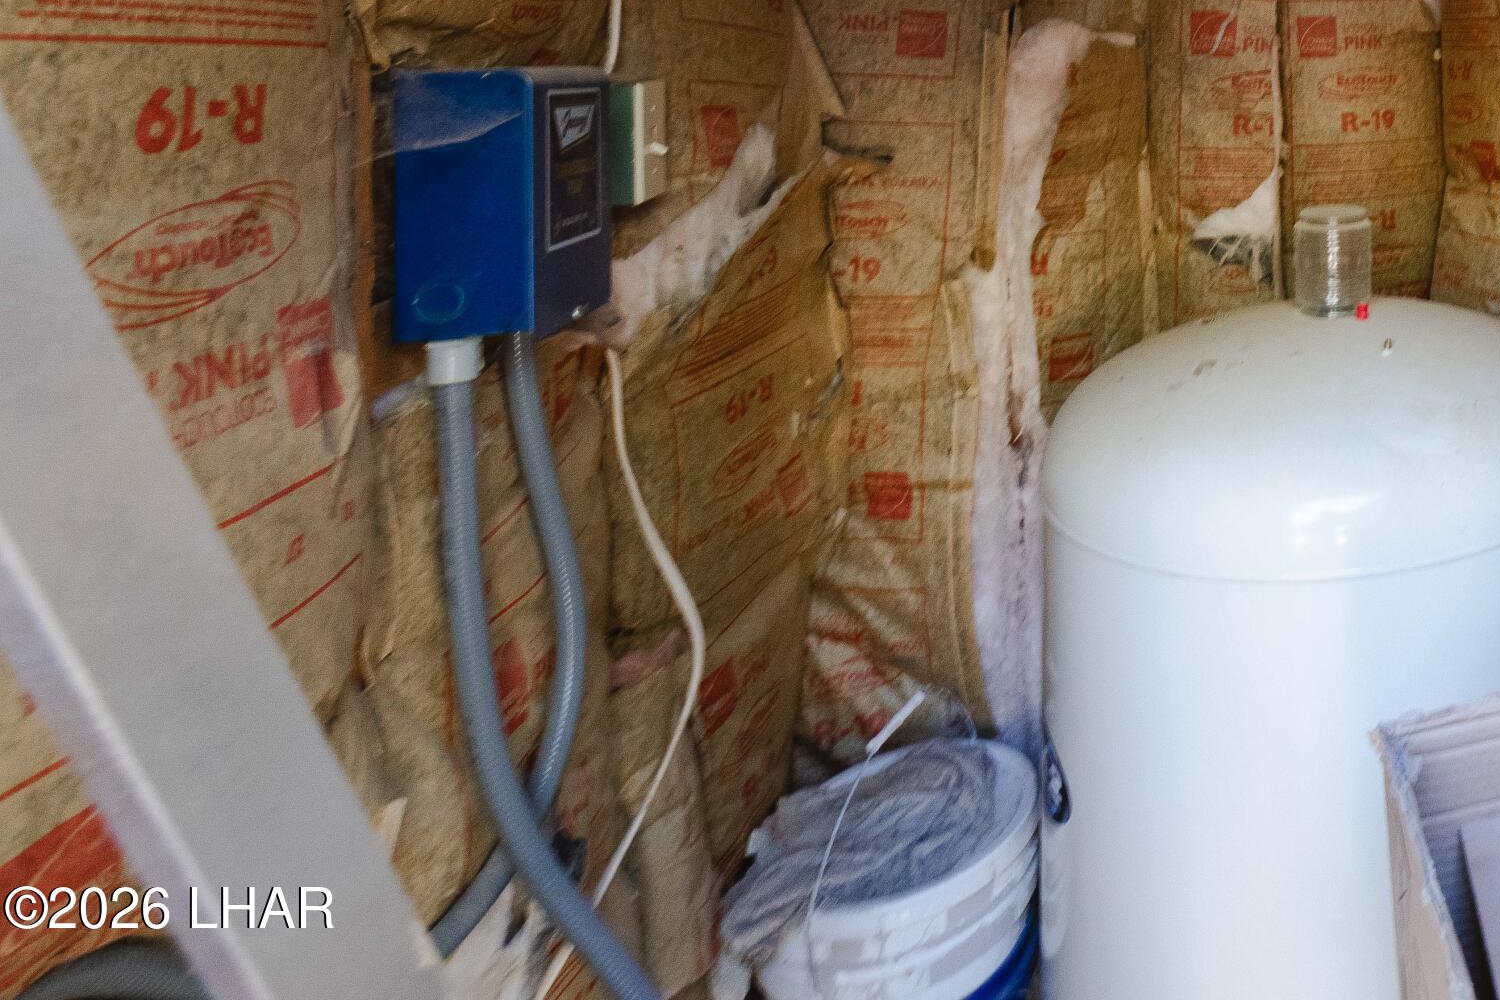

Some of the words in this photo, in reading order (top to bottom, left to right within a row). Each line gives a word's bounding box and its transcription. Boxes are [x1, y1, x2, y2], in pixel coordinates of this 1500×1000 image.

[839, 13, 890, 33] PINK
[1244, 36, 1273, 53] PIN
[1344, 36, 1383, 51] PINK
[134, 83, 268, 155] R-19
[1233, 112, 1274, 136] R-1
[1340, 109, 1397, 133] R-19
[126, 222, 274, 285] EcoTouch
[832, 256, 882, 283] -19
[168, 342, 271, 412] PINK
